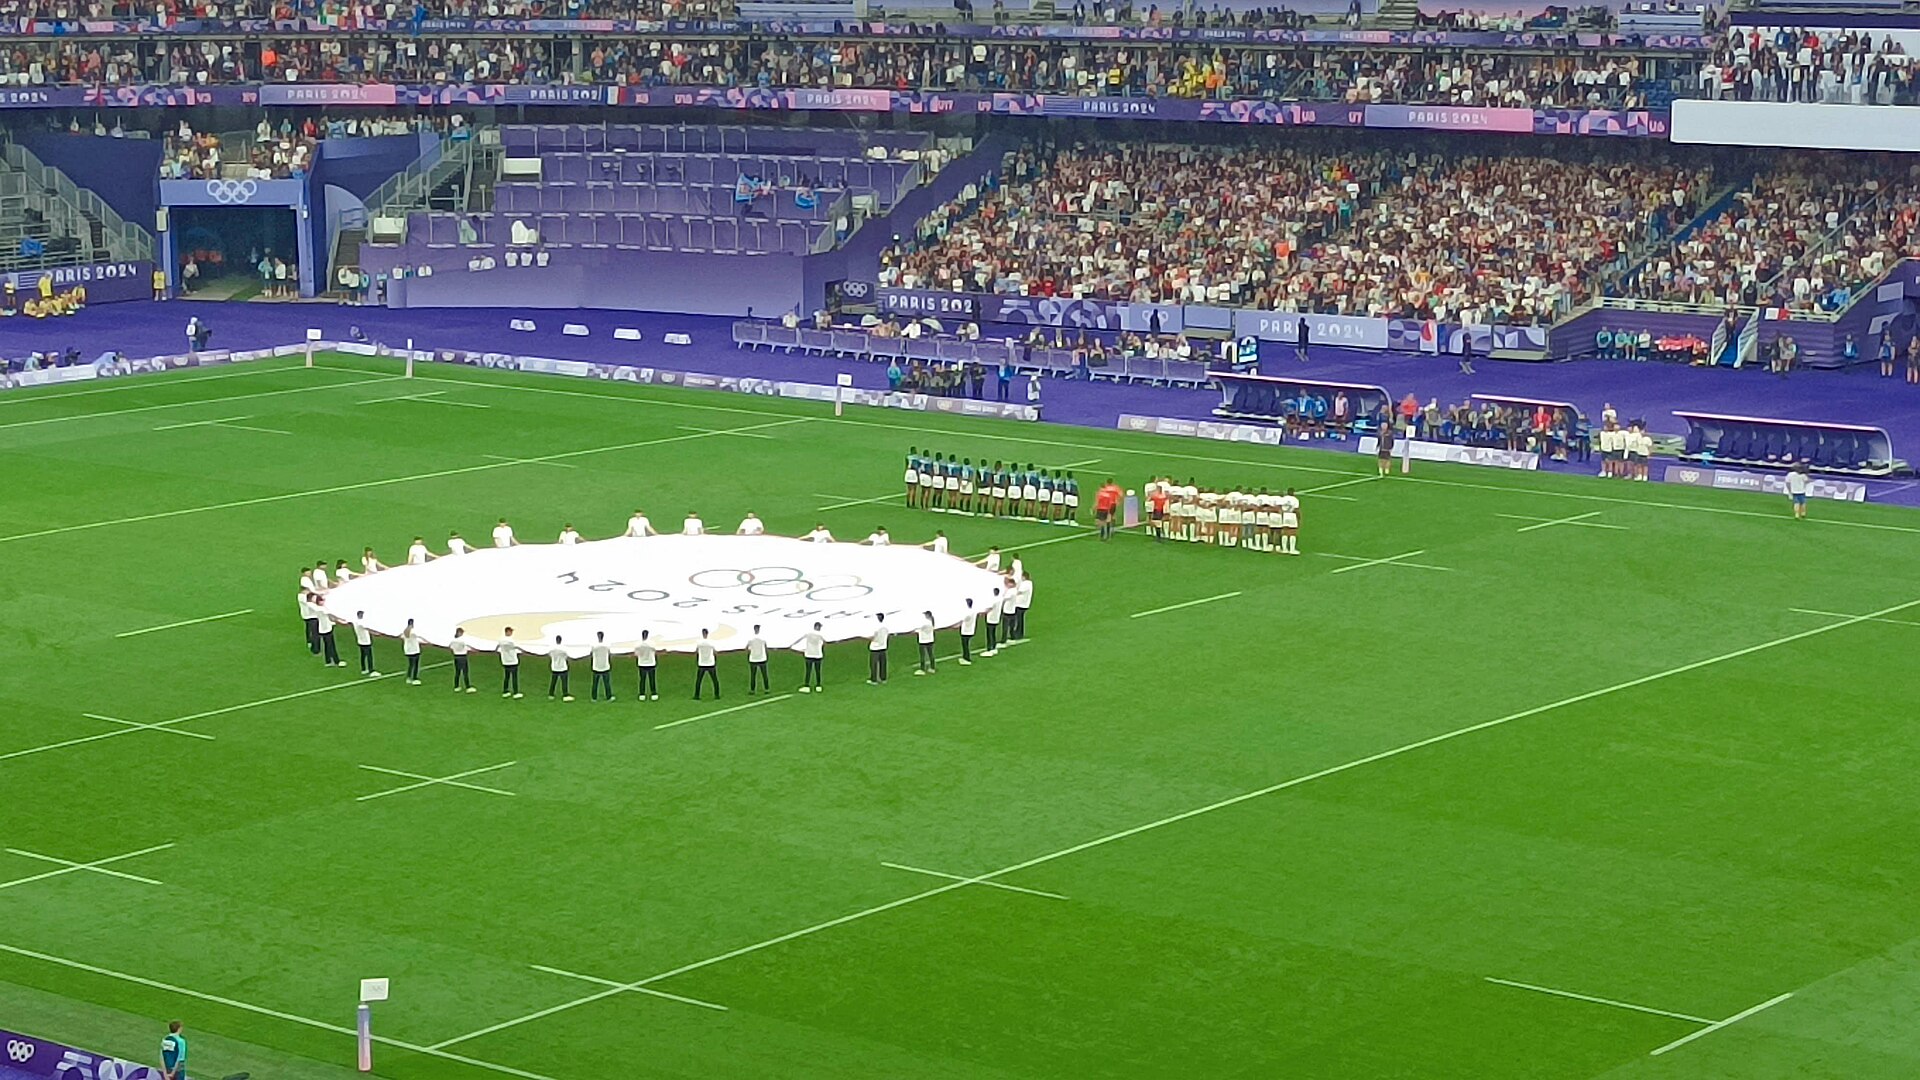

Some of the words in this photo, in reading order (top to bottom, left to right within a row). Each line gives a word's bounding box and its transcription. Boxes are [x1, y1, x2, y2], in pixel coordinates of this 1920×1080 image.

[10, 92, 48, 103] 2024
[287, 89, 328, 100] PARIS
[331, 89, 368, 100] 2024
[530, 89, 569, 100] PARIS
[572, 89, 599, 100] 202
[807, 93, 842, 104] PARIS
[1083, 101, 1119, 113] PARIS
[1122, 102, 1155, 114] 2024
[1408, 111, 1448, 123] PARIS
[1452, 113, 1488, 125] 2024
[95, 263, 138, 280] 2024
[888, 294, 936, 311] PARIS
[1259, 318, 1311, 337] PARI
[1316, 322, 1365, 339] 2024
